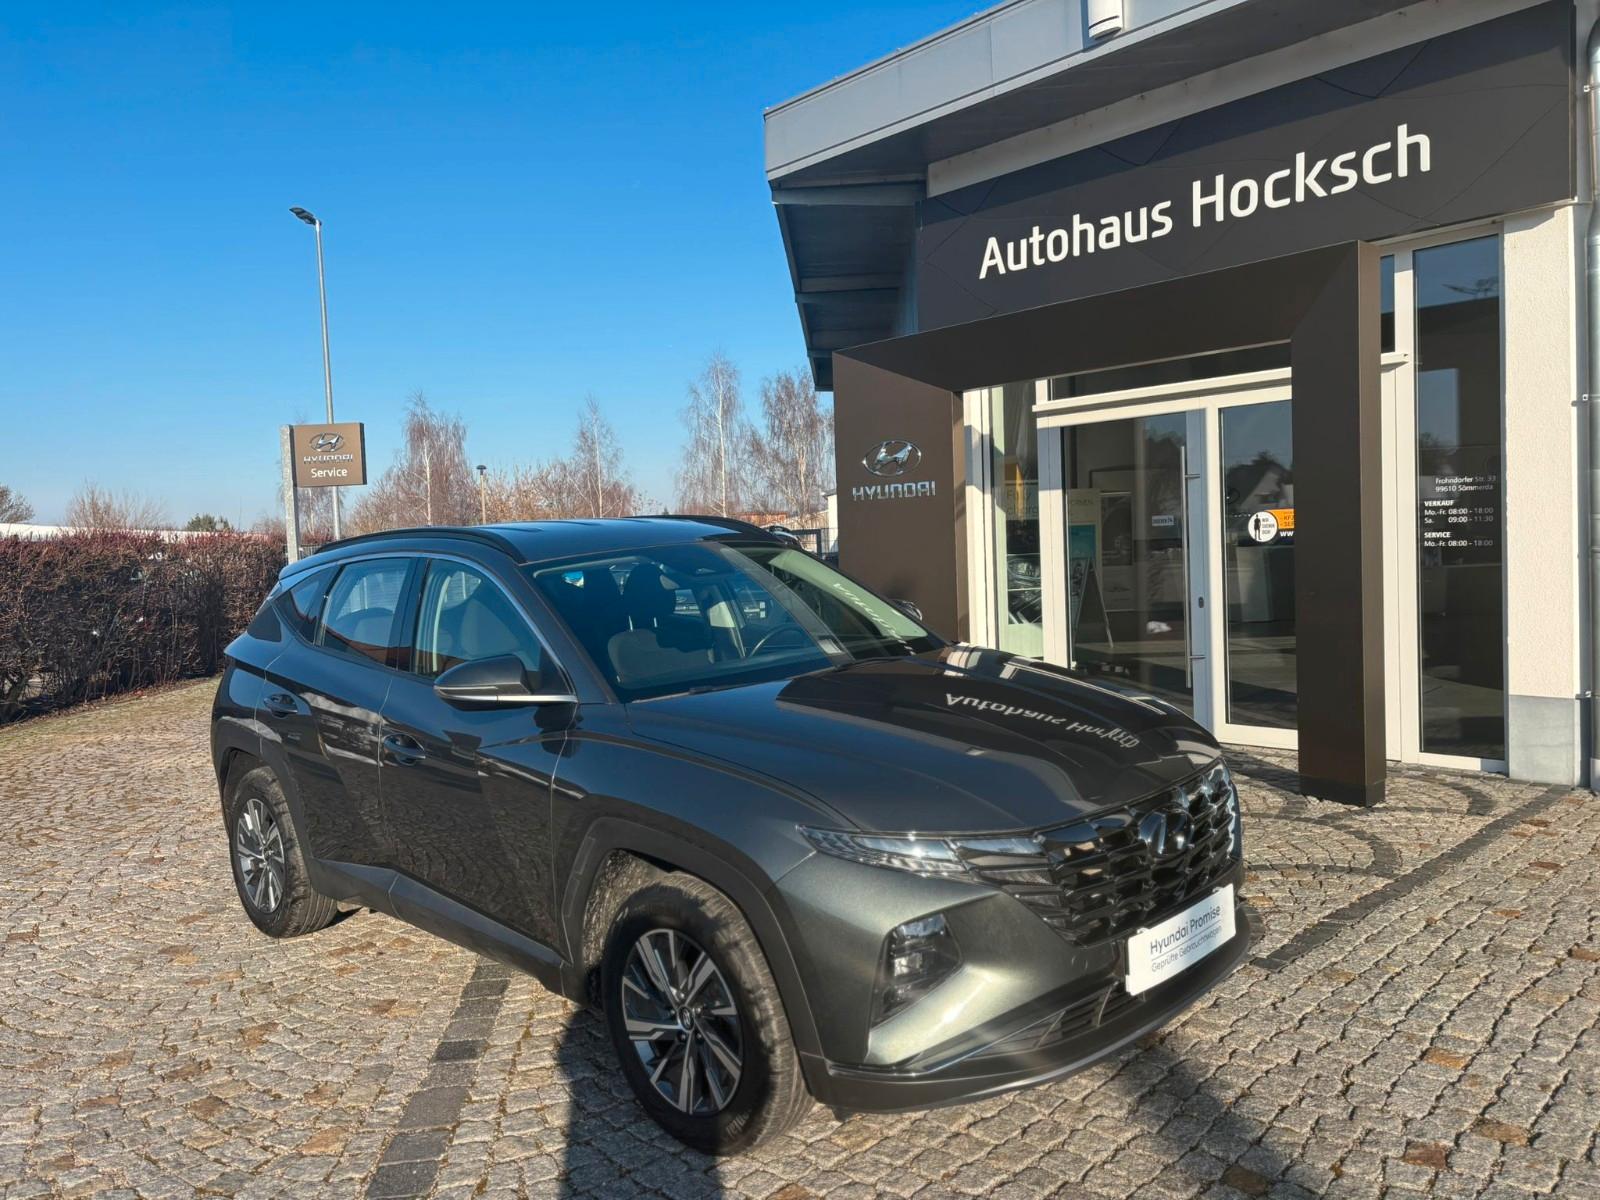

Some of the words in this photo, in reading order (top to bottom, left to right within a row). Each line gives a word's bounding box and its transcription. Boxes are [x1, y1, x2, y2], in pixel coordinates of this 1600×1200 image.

[979, 200, 1173, 280] Autohaus
[1192, 123, 1432, 228] Hocksch
[303, 454, 353, 464] HYUNDAI
[311, 467, 348, 478] Service
[852, 481, 936, 501] HYUNDAI
[1150, 920, 1189, 955] Hyundai
[1190, 905, 1221, 934] Promise
